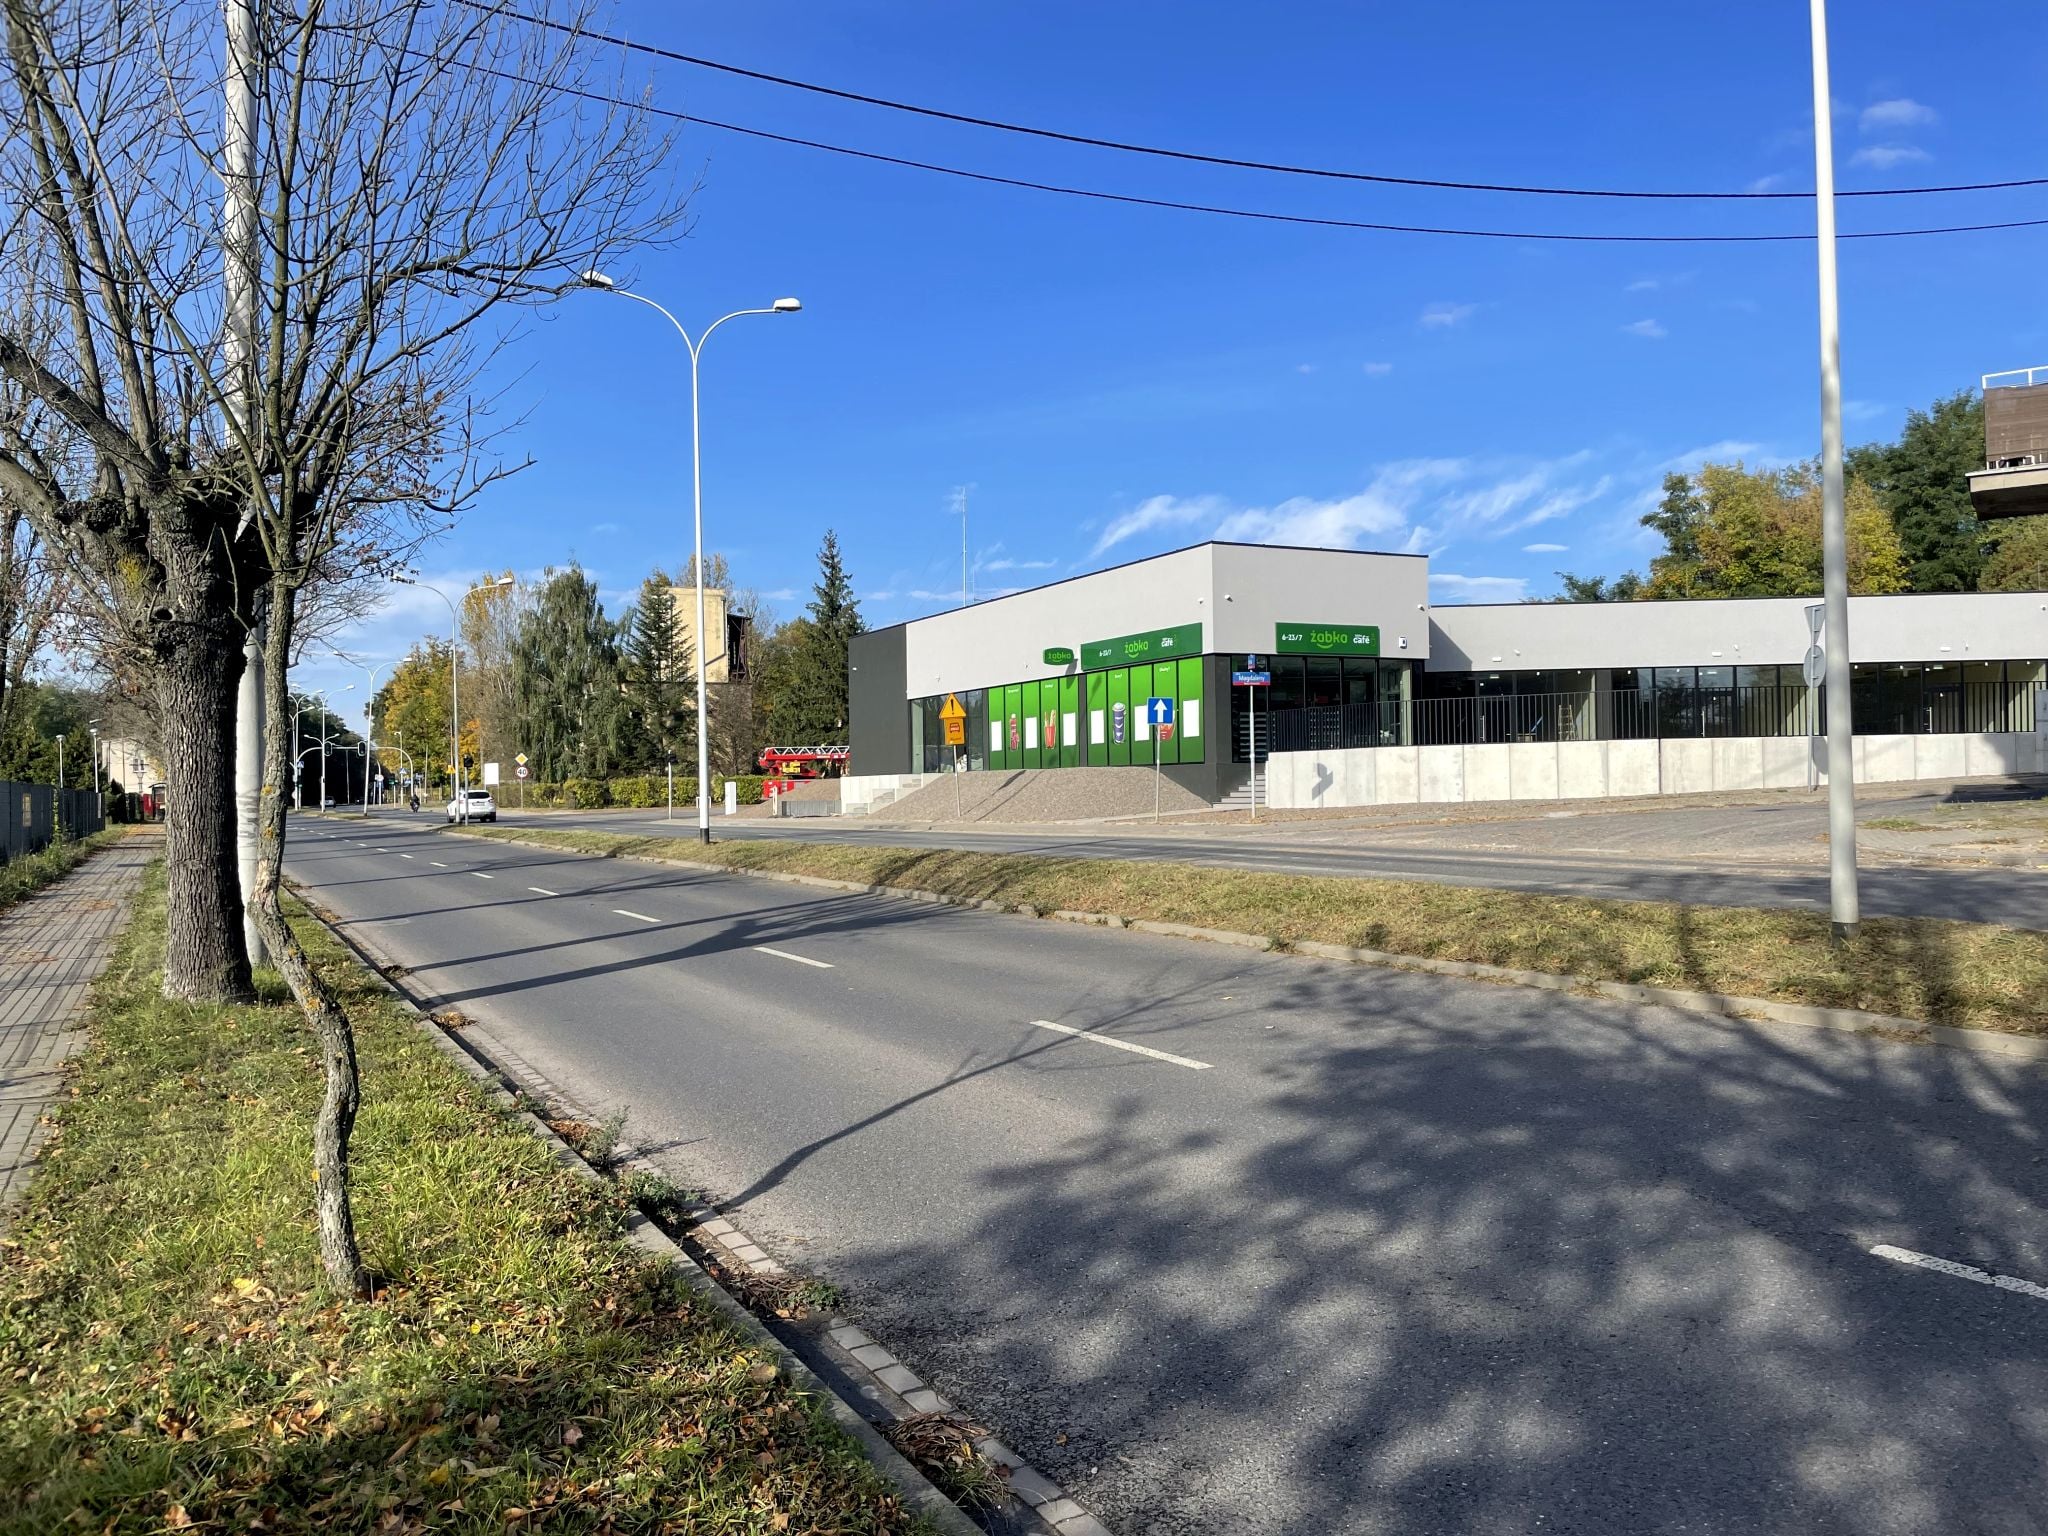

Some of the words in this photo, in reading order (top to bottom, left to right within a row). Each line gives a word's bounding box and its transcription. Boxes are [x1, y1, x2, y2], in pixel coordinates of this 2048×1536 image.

[1310, 630, 1348, 644] żabka
[1353, 634, 1370, 644] café
[1124, 640, 1149, 655] żabka
[517, 767, 527, 775] 40
